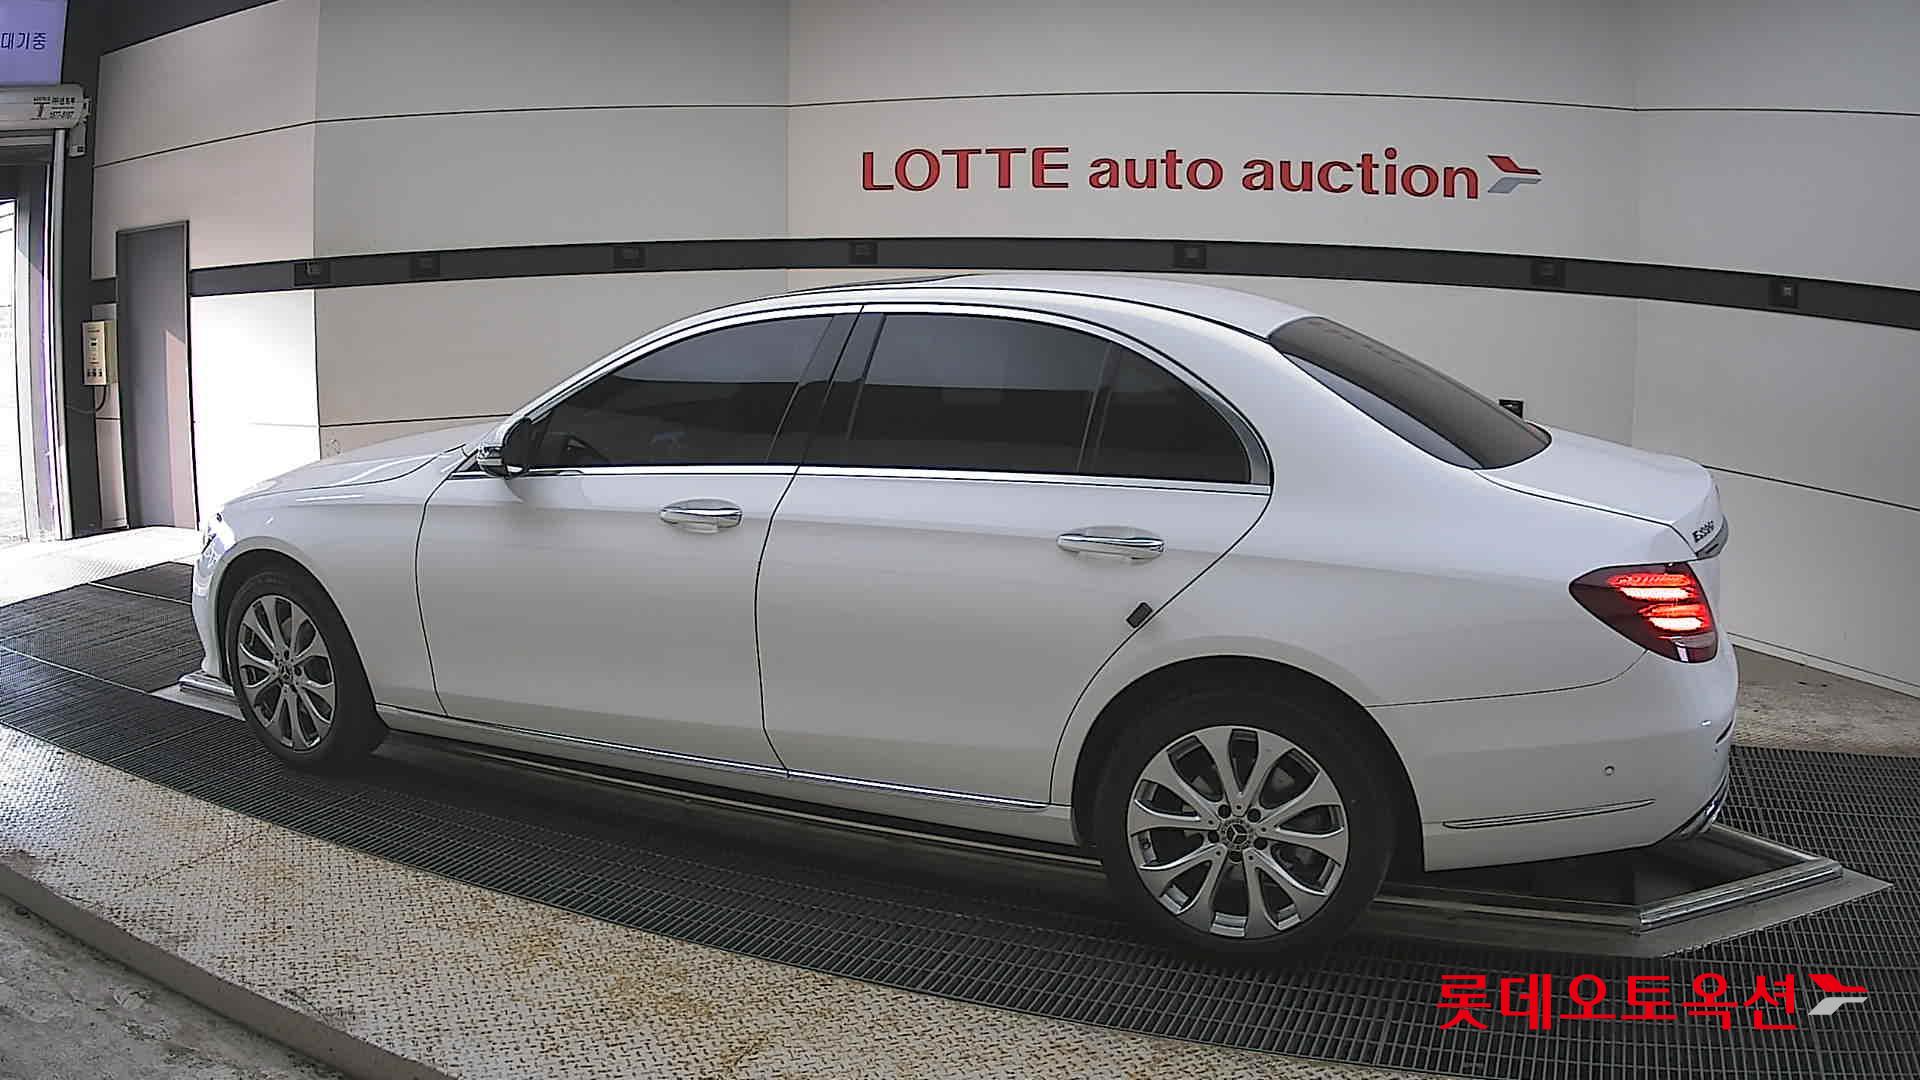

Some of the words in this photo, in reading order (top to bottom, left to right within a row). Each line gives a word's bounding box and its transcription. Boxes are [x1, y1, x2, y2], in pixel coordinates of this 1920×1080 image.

[1, 32, 48, 50] 대기중
[862, 147, 1069, 191] LOTTE
[1089, 149, 1224, 190] auto
[1242, 148, 1479, 199] auction
